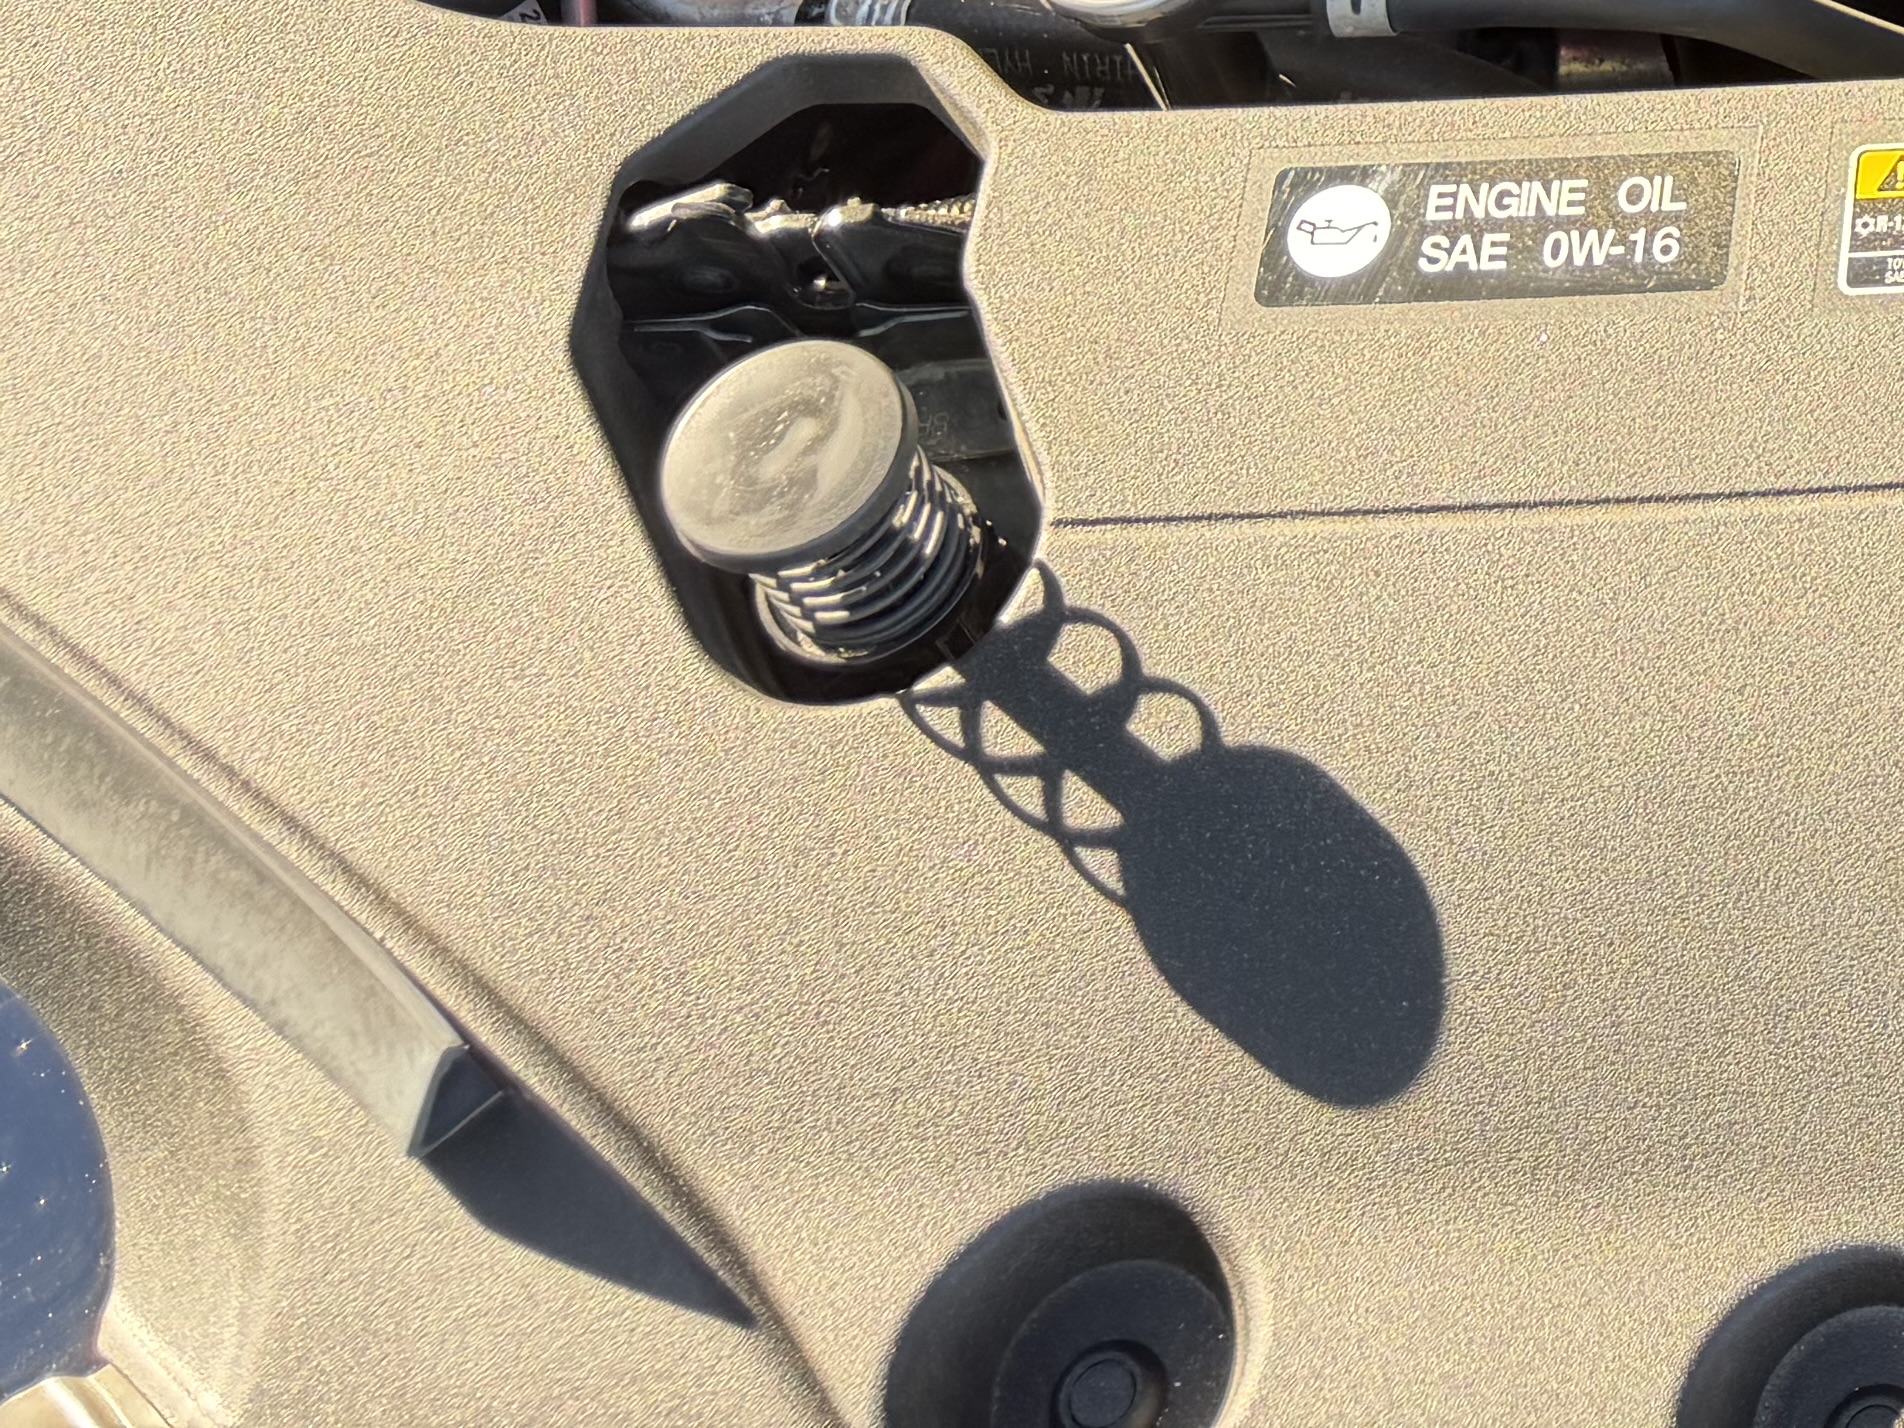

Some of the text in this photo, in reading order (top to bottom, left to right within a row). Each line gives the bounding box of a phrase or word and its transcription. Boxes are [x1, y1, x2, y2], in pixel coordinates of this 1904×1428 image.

[1424, 174, 1687, 221] ENGINE OIL
[1418, 226, 1682, 273] SAE 0W-16
